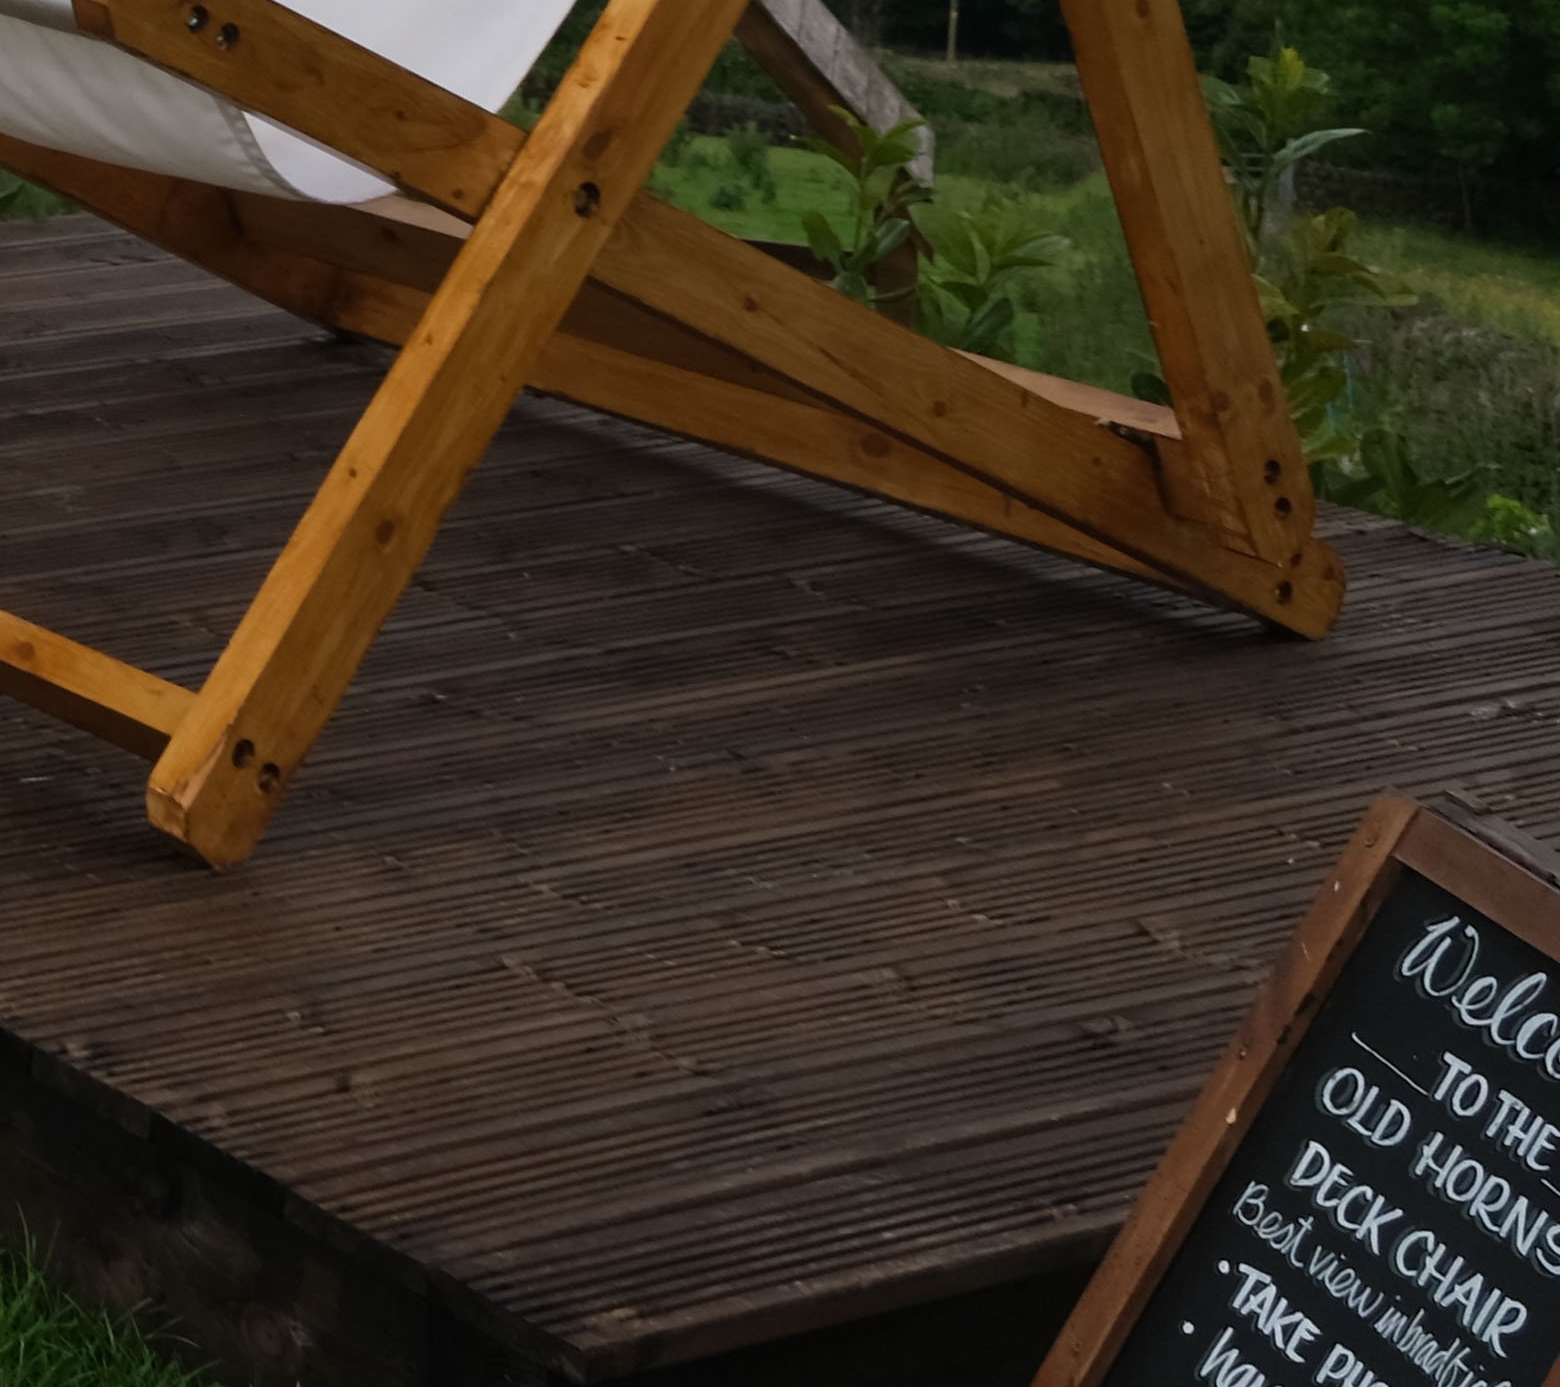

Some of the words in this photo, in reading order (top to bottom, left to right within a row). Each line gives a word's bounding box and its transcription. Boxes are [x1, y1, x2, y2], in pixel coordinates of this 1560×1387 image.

[1322, 1067, 1412, 1146] OLD
[1434, 1051, 1489, 1117] TO
[1485, 1089, 1560, 1171] THE
[1232, 1180, 1314, 1268] Best
[1309, 1245, 1385, 1319] view
[1289, 1140, 1404, 1256] DECK
[1395, 1230, 1528, 1359] CHAIR
[1231, 1262, 1323, 1364] TAKE
